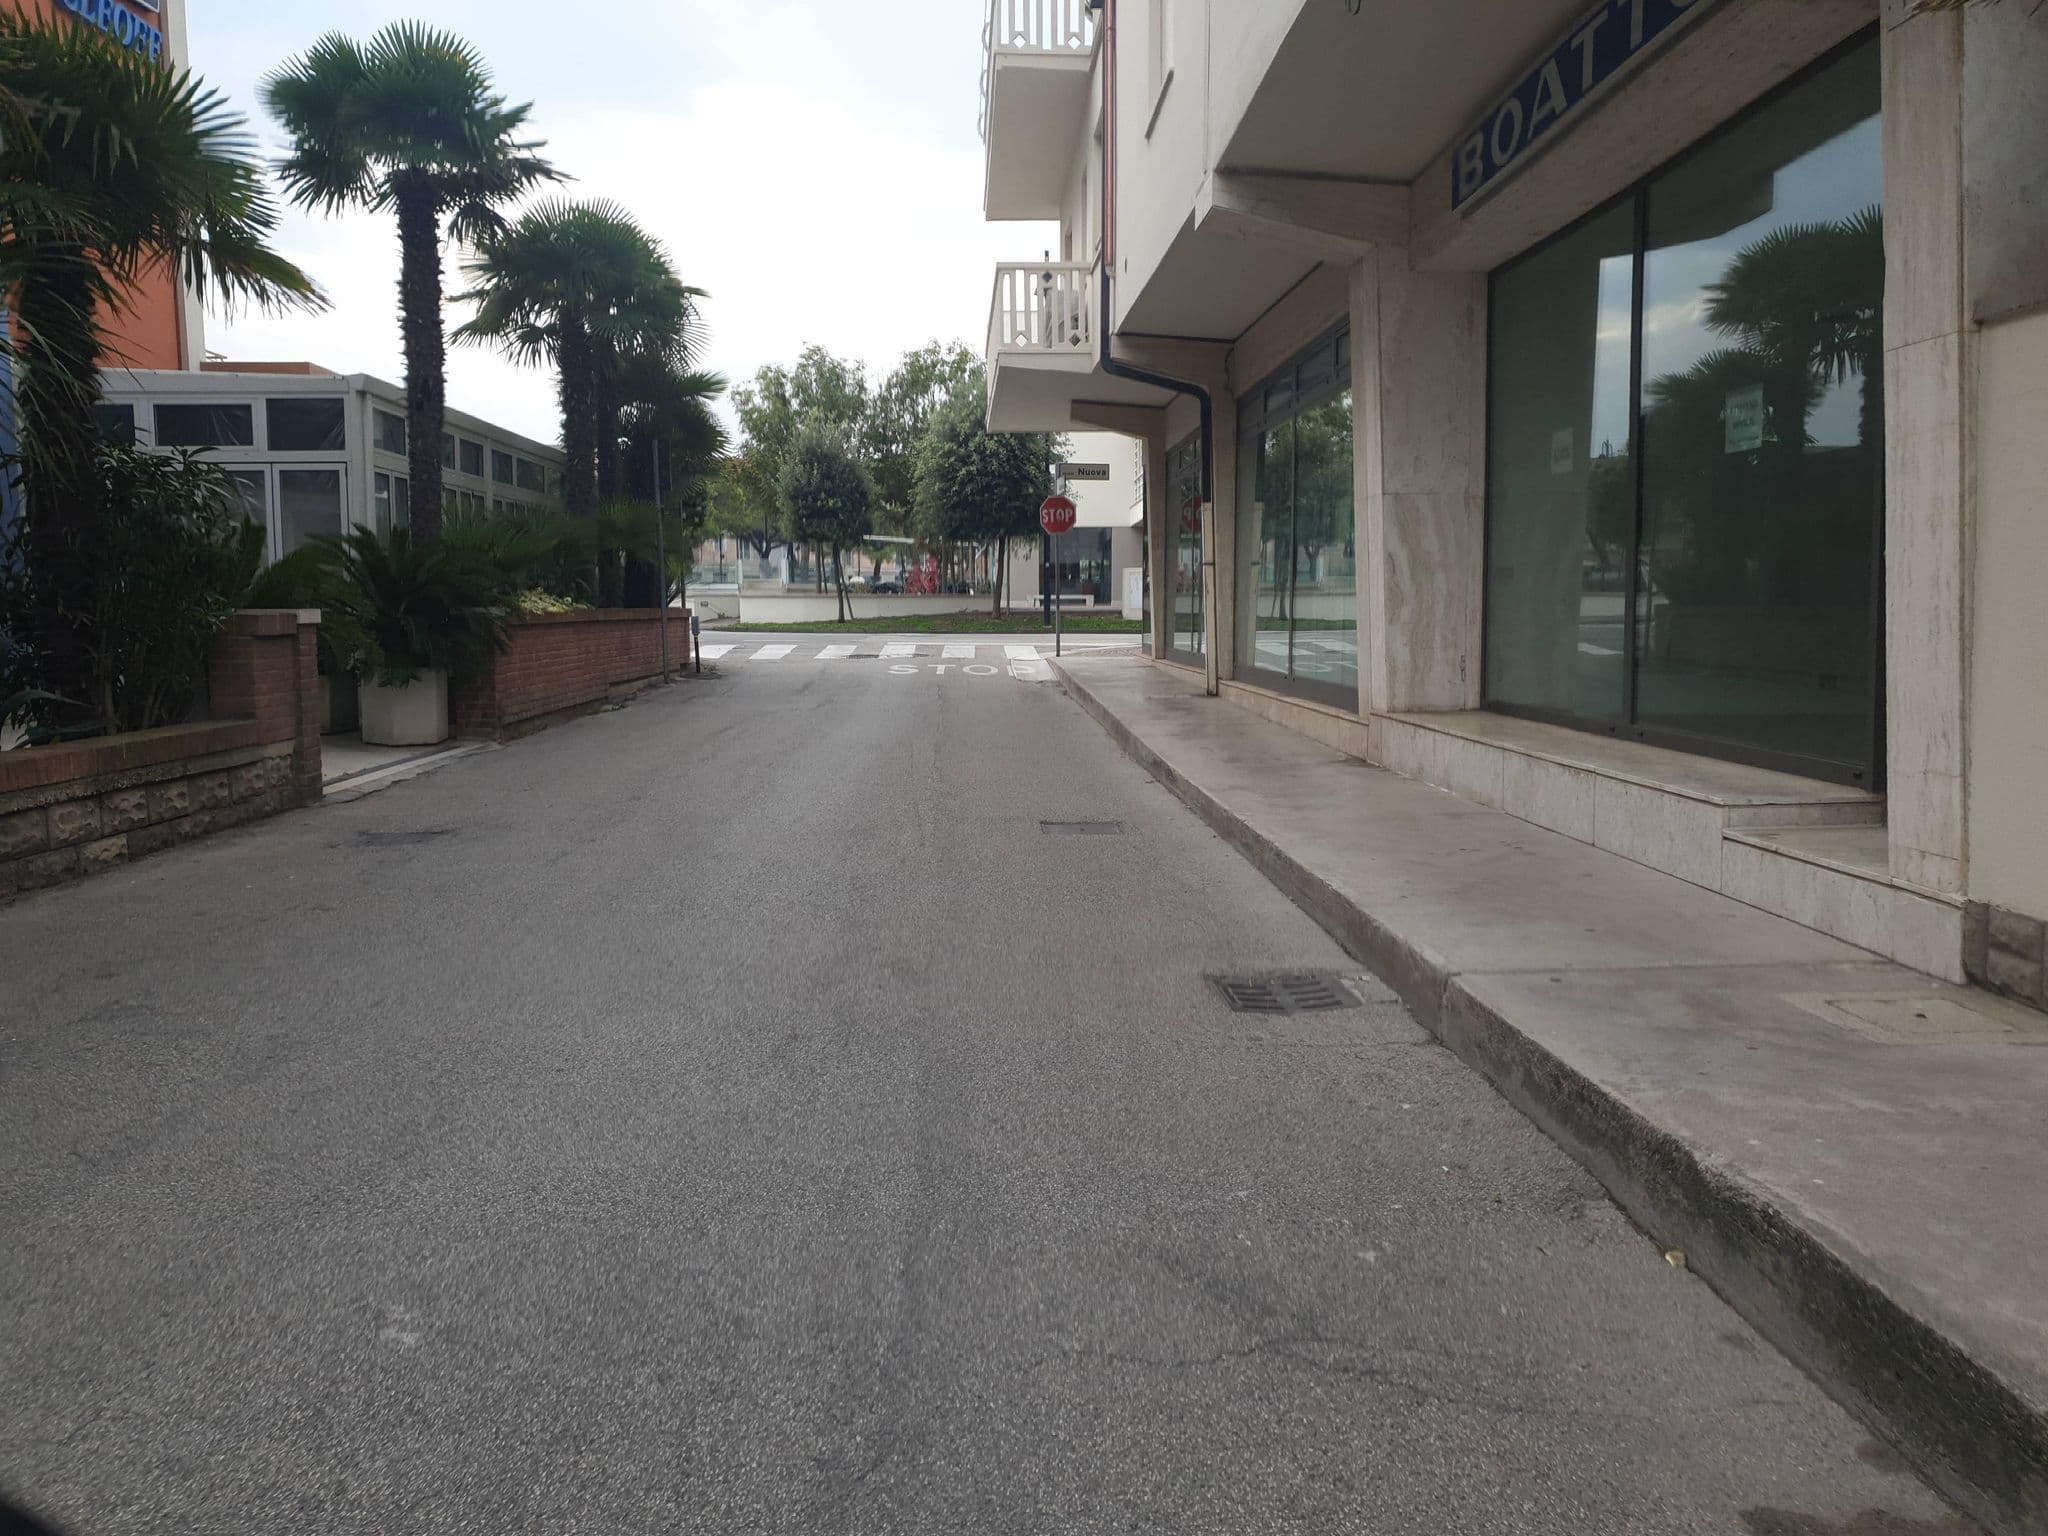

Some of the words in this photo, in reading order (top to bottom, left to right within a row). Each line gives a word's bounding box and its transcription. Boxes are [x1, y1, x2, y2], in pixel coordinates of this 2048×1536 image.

[1458, 0, 1694, 201] BOATT
[1078, 467, 1106, 476] Nuova
[1042, 508, 1073, 523] STOP
[888, 664, 1034, 676] STOP
